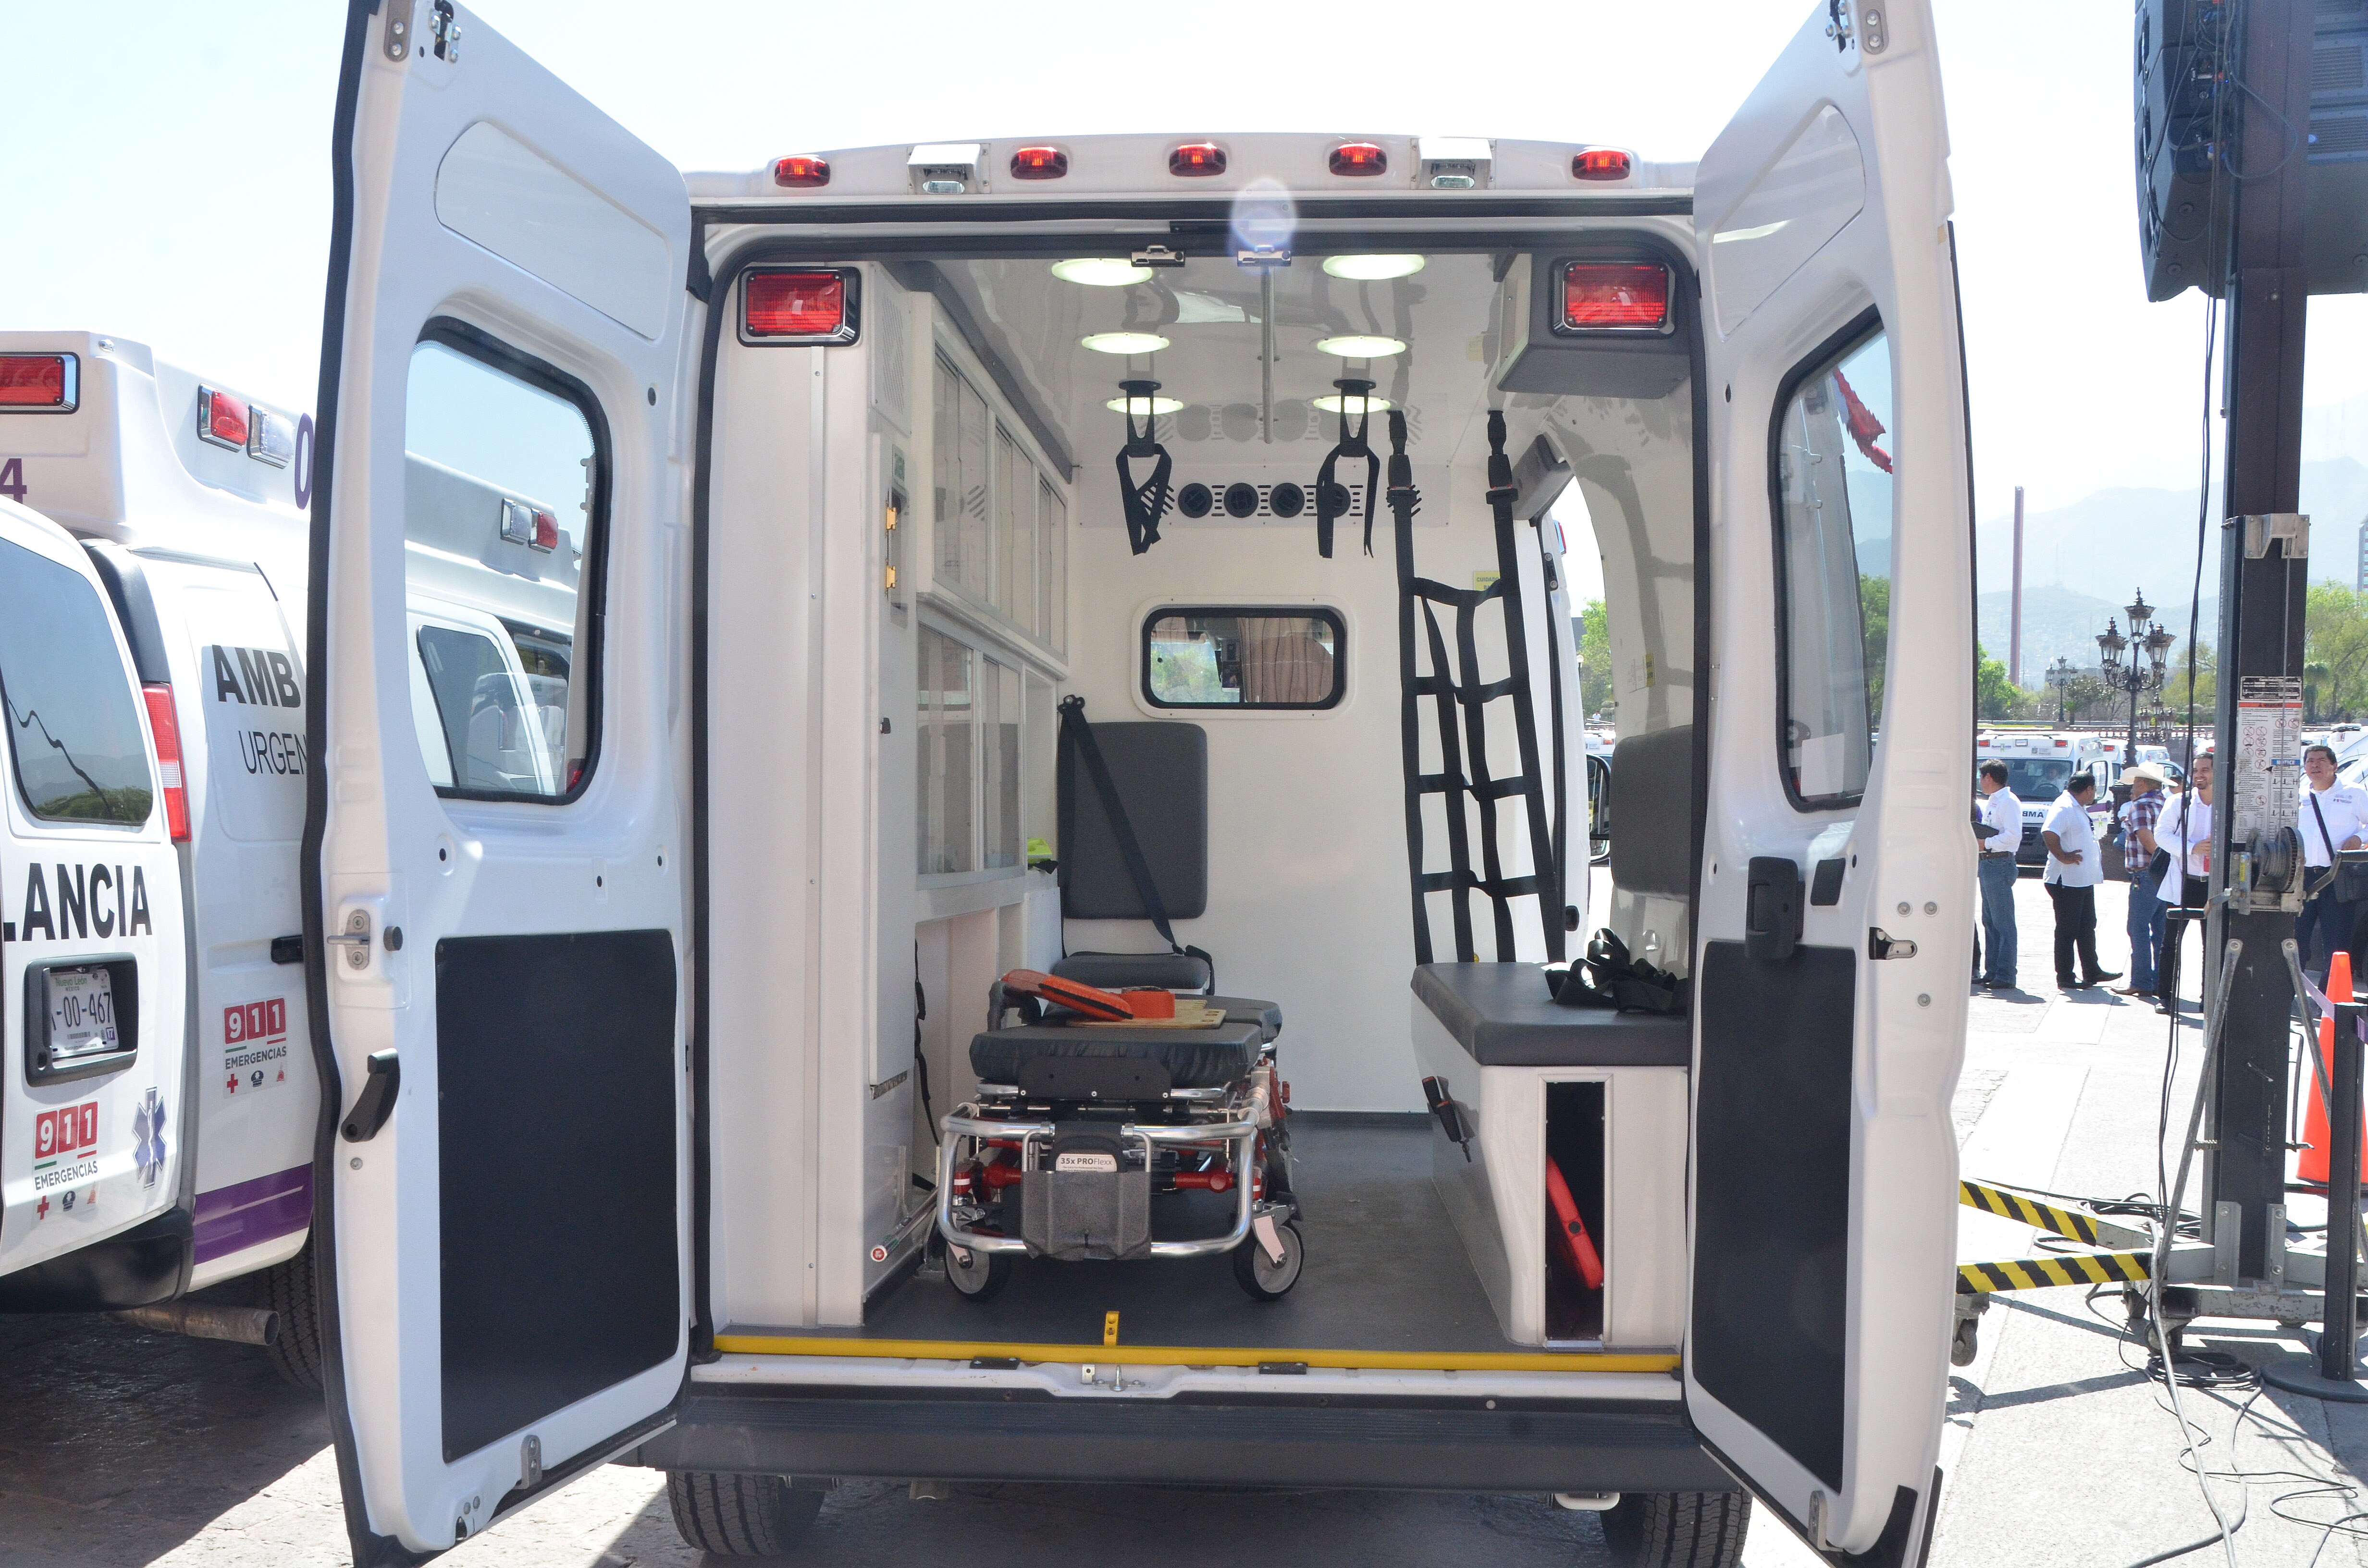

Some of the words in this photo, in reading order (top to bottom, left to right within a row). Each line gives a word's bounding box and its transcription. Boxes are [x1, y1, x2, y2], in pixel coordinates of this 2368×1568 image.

[212, 644, 301, 708] AMB
[51, 992, 111, 1031] -00-467
[229, 1004, 280, 1039] 911
[225, 1046, 287, 1070] EMERGENCIAS
[40, 1109, 92, 1152] 911
[35, 1161, 98, 1190] EMERGENCIAS
